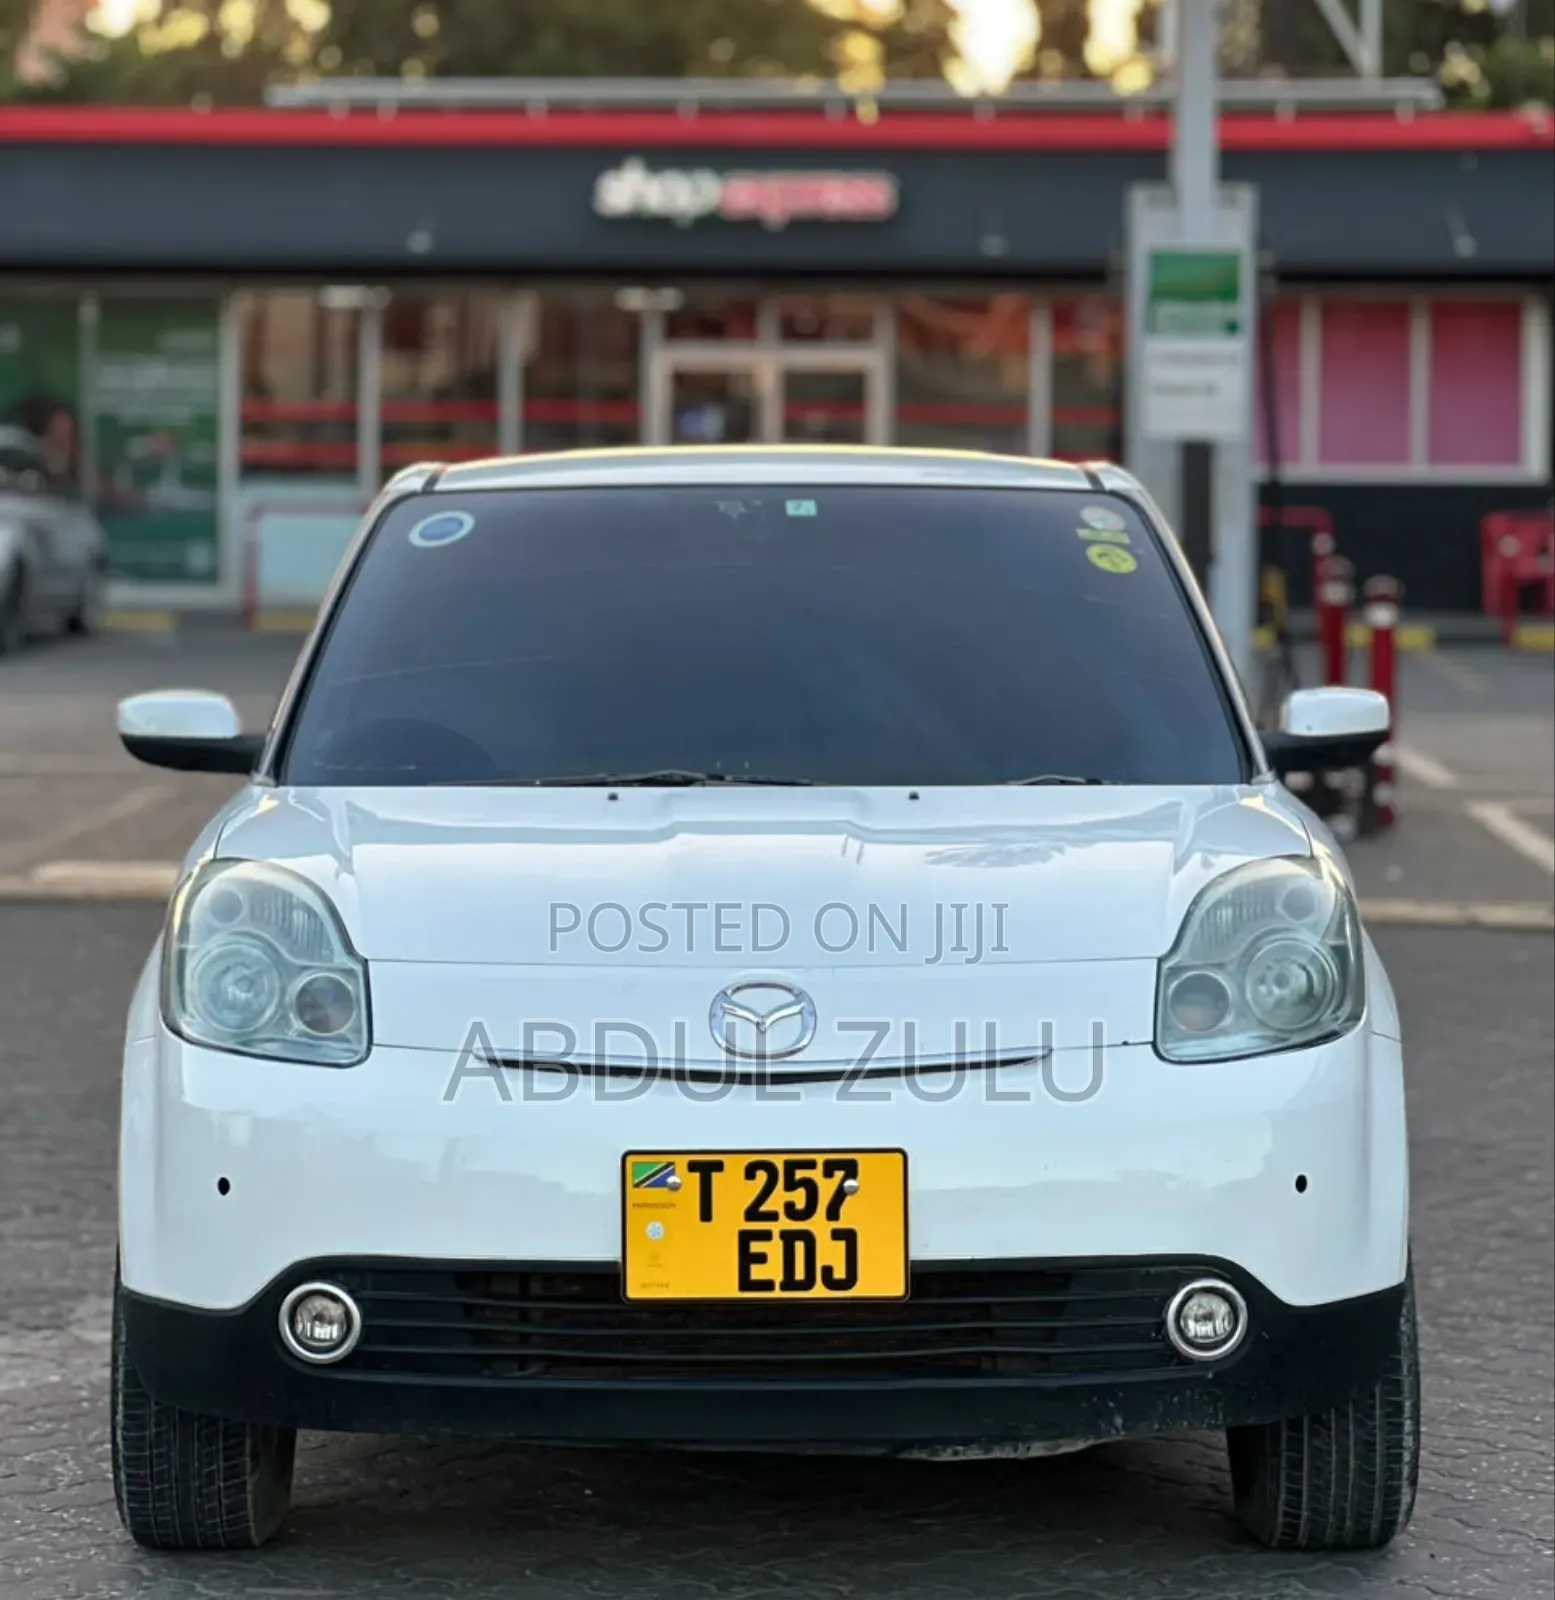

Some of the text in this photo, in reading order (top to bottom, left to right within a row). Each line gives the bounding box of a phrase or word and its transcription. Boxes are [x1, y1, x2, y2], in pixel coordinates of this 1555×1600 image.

[687, 1158, 859, 1223] T 257
[738, 1227, 859, 1293] EDJ
